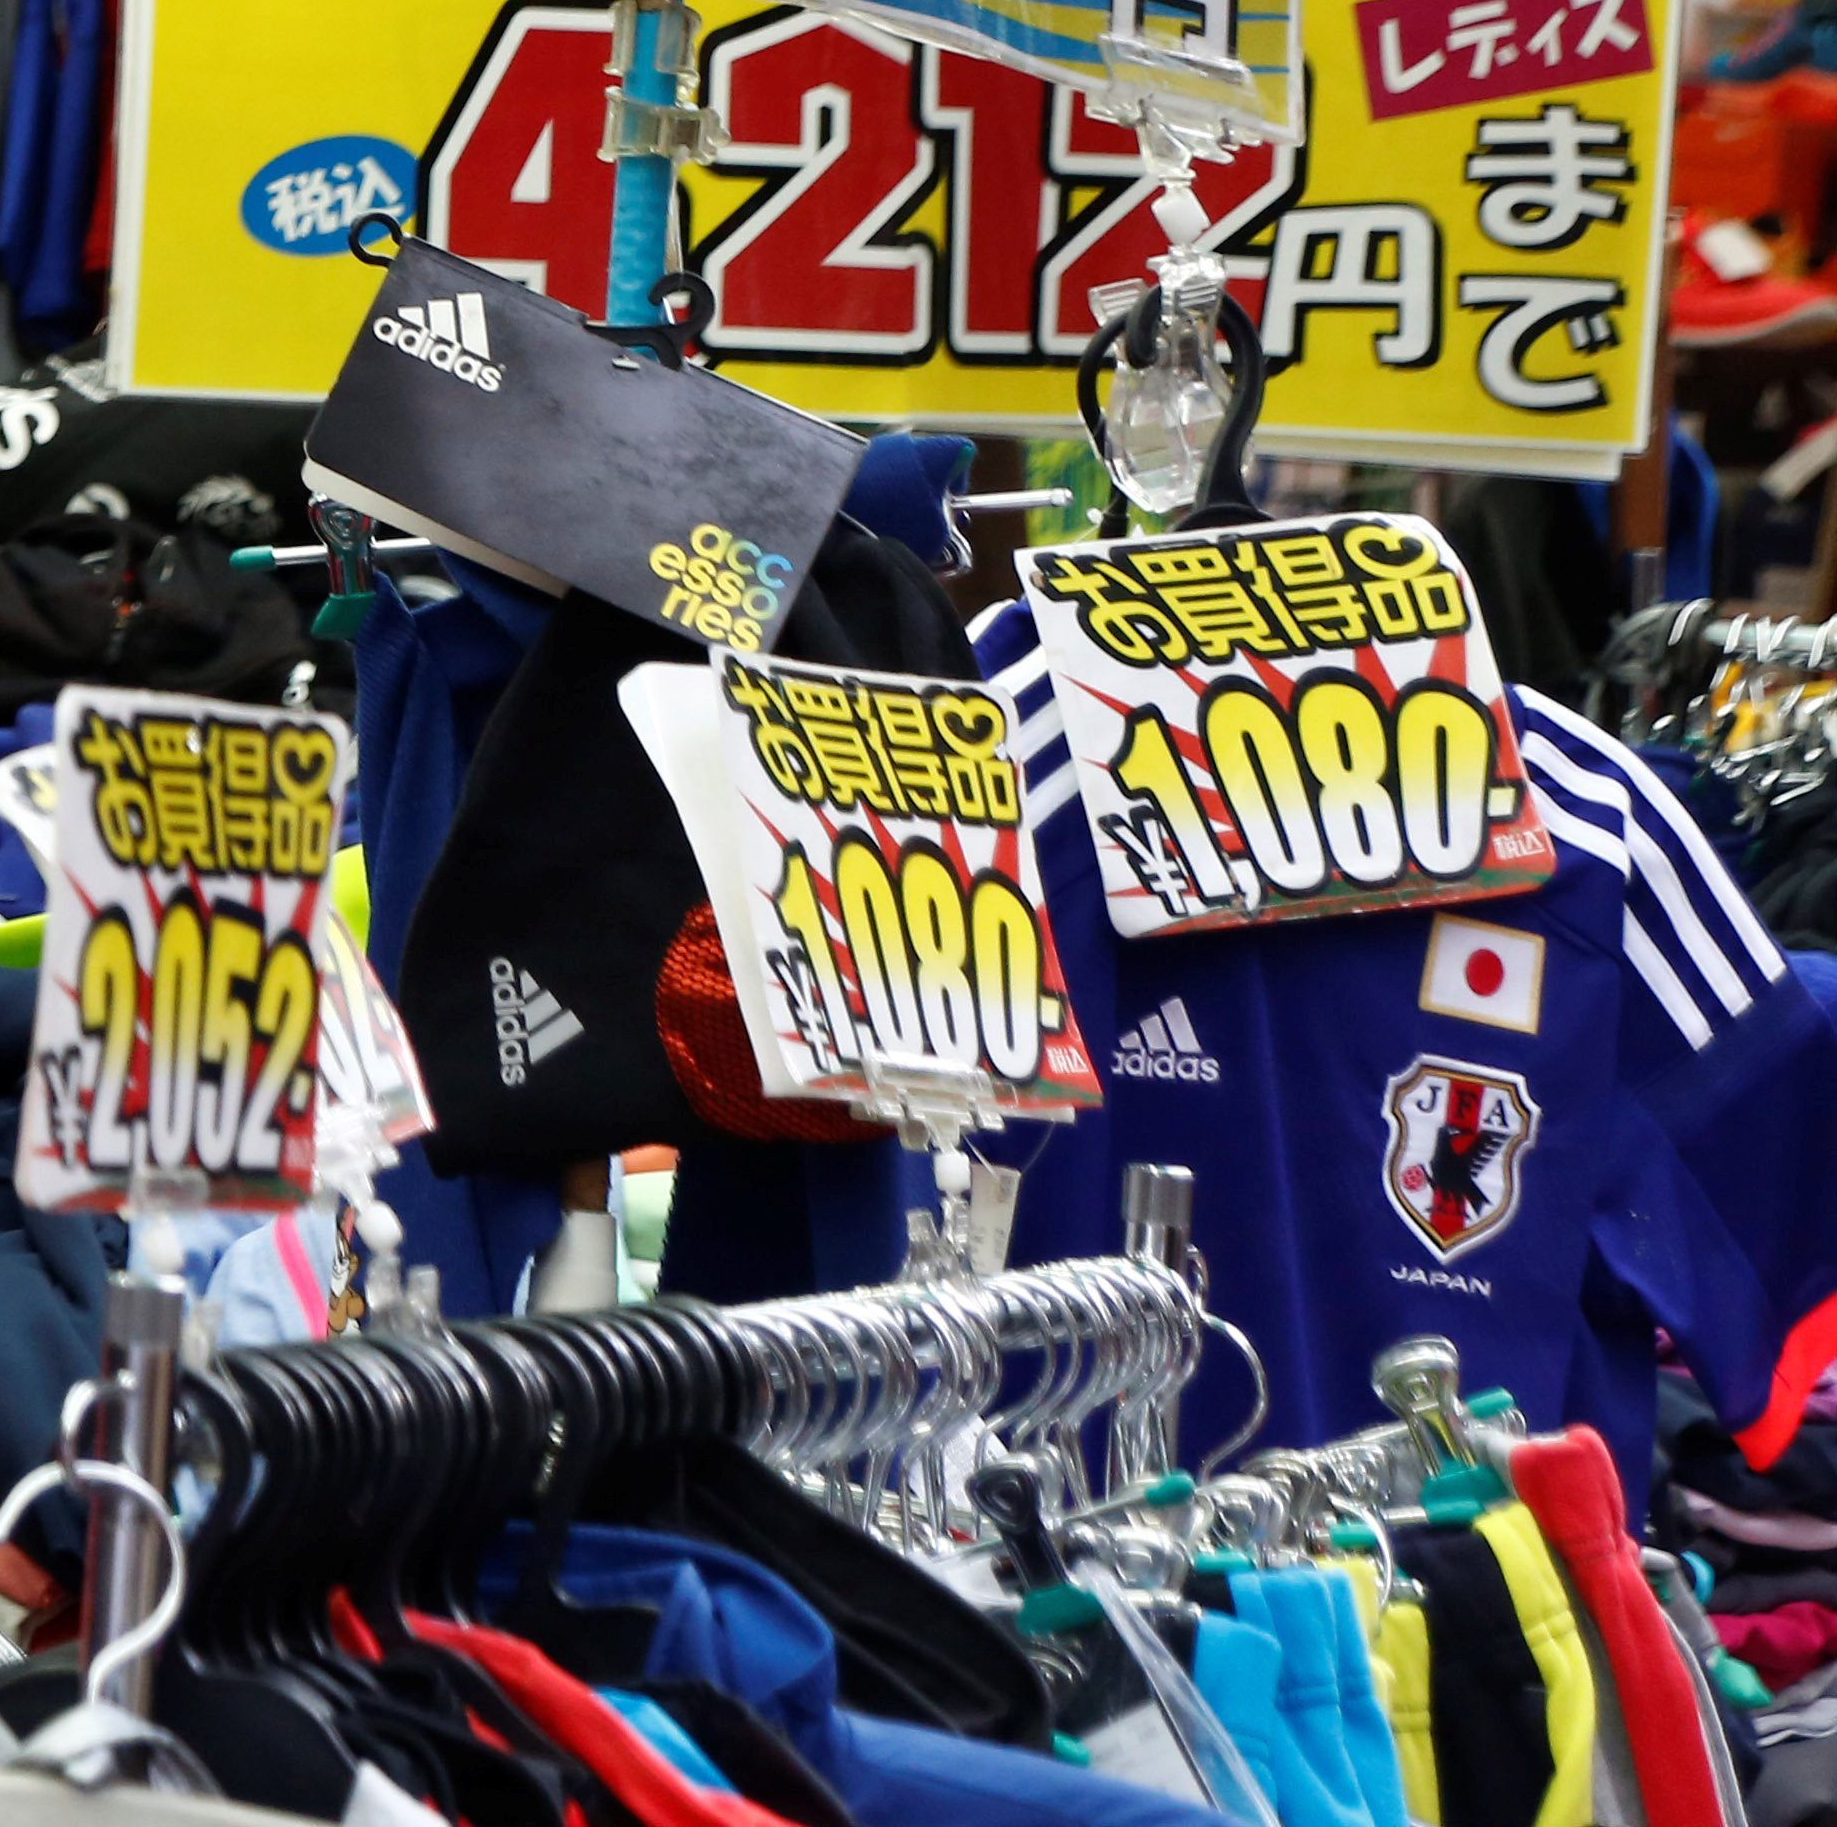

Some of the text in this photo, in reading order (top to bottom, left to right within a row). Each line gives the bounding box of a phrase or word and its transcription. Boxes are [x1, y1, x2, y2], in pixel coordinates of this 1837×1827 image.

[262, 155, 406, 243] 税込
[1456, 101, 1638, 415] まで
[371, 313, 506, 397] adidas
[1036, 519, 1472, 669] お買得品
[73, 707, 338, 875] お買得品
[722, 653, 1022, 828] お買得品
[488, 954, 526, 1088] adidas
[1111, 1047, 1220, 1083] adidas
[1388, 1263, 1494, 1301] JAPAN
